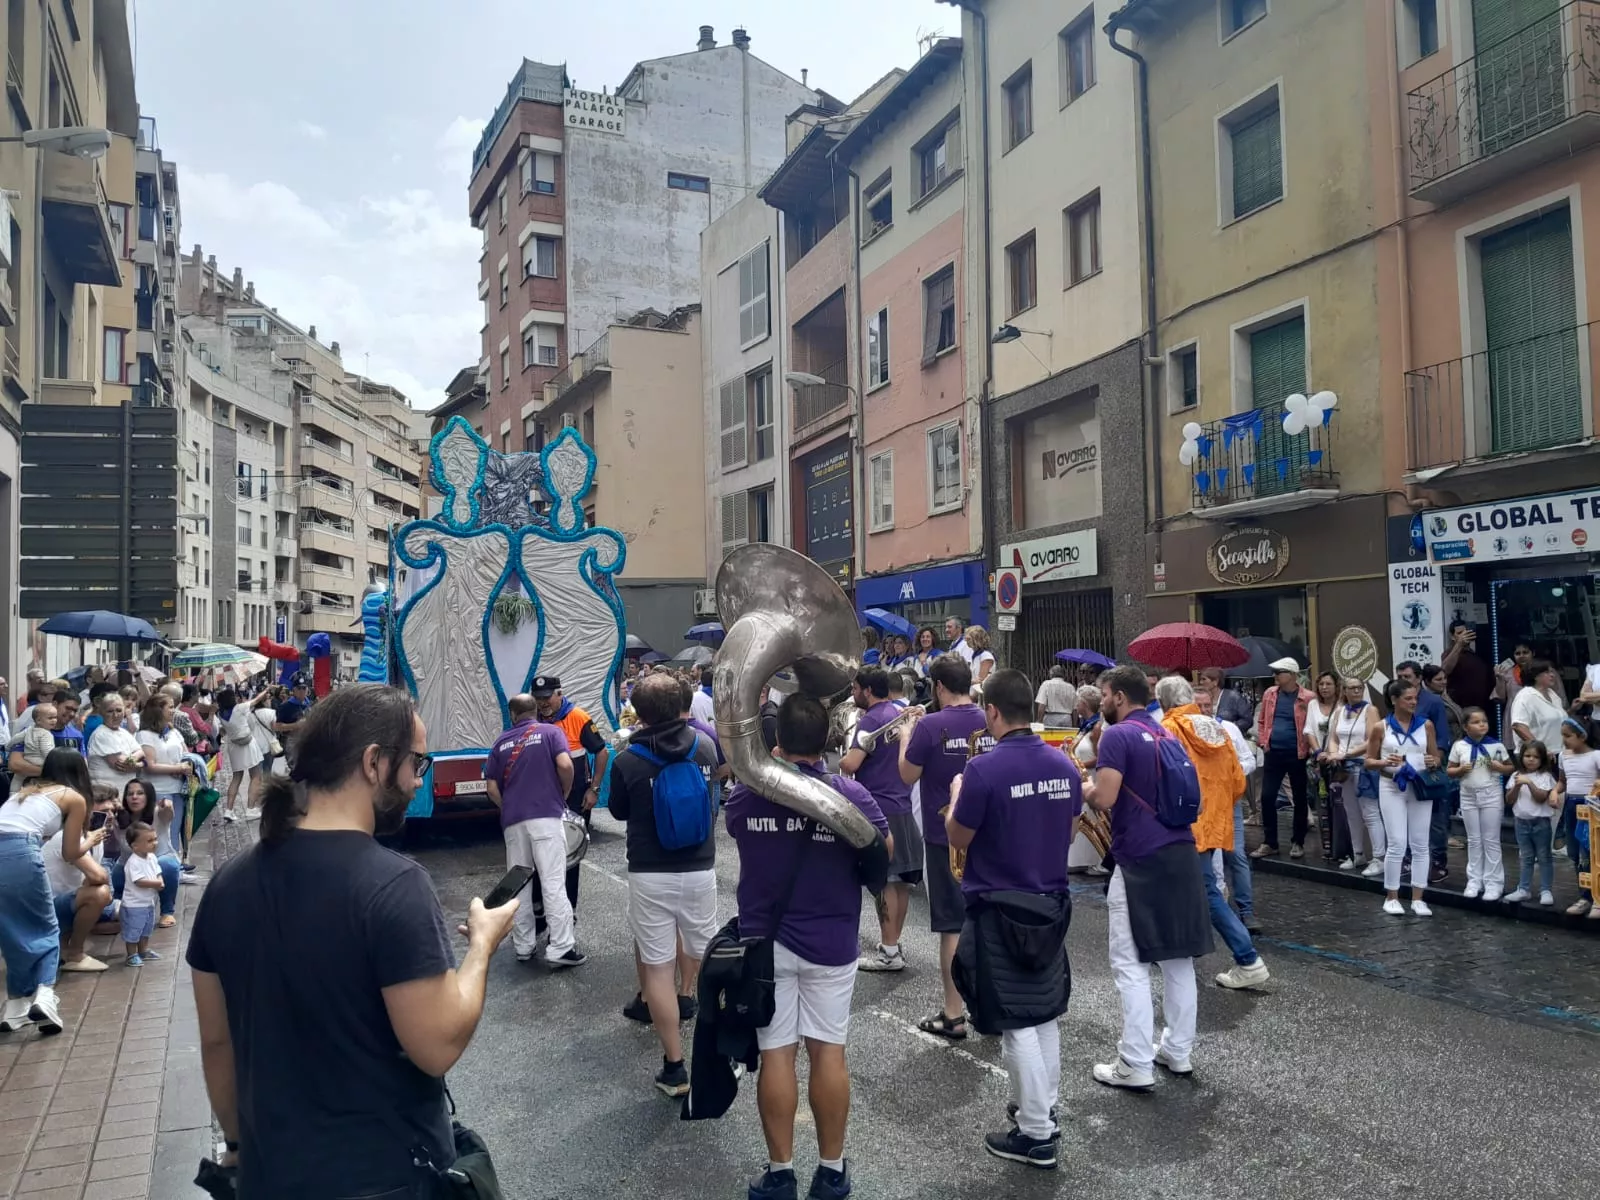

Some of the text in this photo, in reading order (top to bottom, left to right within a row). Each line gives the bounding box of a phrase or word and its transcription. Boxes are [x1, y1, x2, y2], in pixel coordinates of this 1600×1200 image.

[570, 89, 619, 106] HOSTAL
[565, 99, 624, 117] PALAFOX
[569, 115, 621, 131] GARAGE
[1457, 502, 1563, 534] GLOBAL
[1218, 538, 1276, 572] Secastilla
[1393, 566, 1436, 580] GLOBAL
[899, 581, 915, 599] AXA
[1400, 581, 1430, 594] TECH
[1010, 778, 1071, 799] MUTIL GAZTEAK
[746, 817, 778, 832] MUTIL
